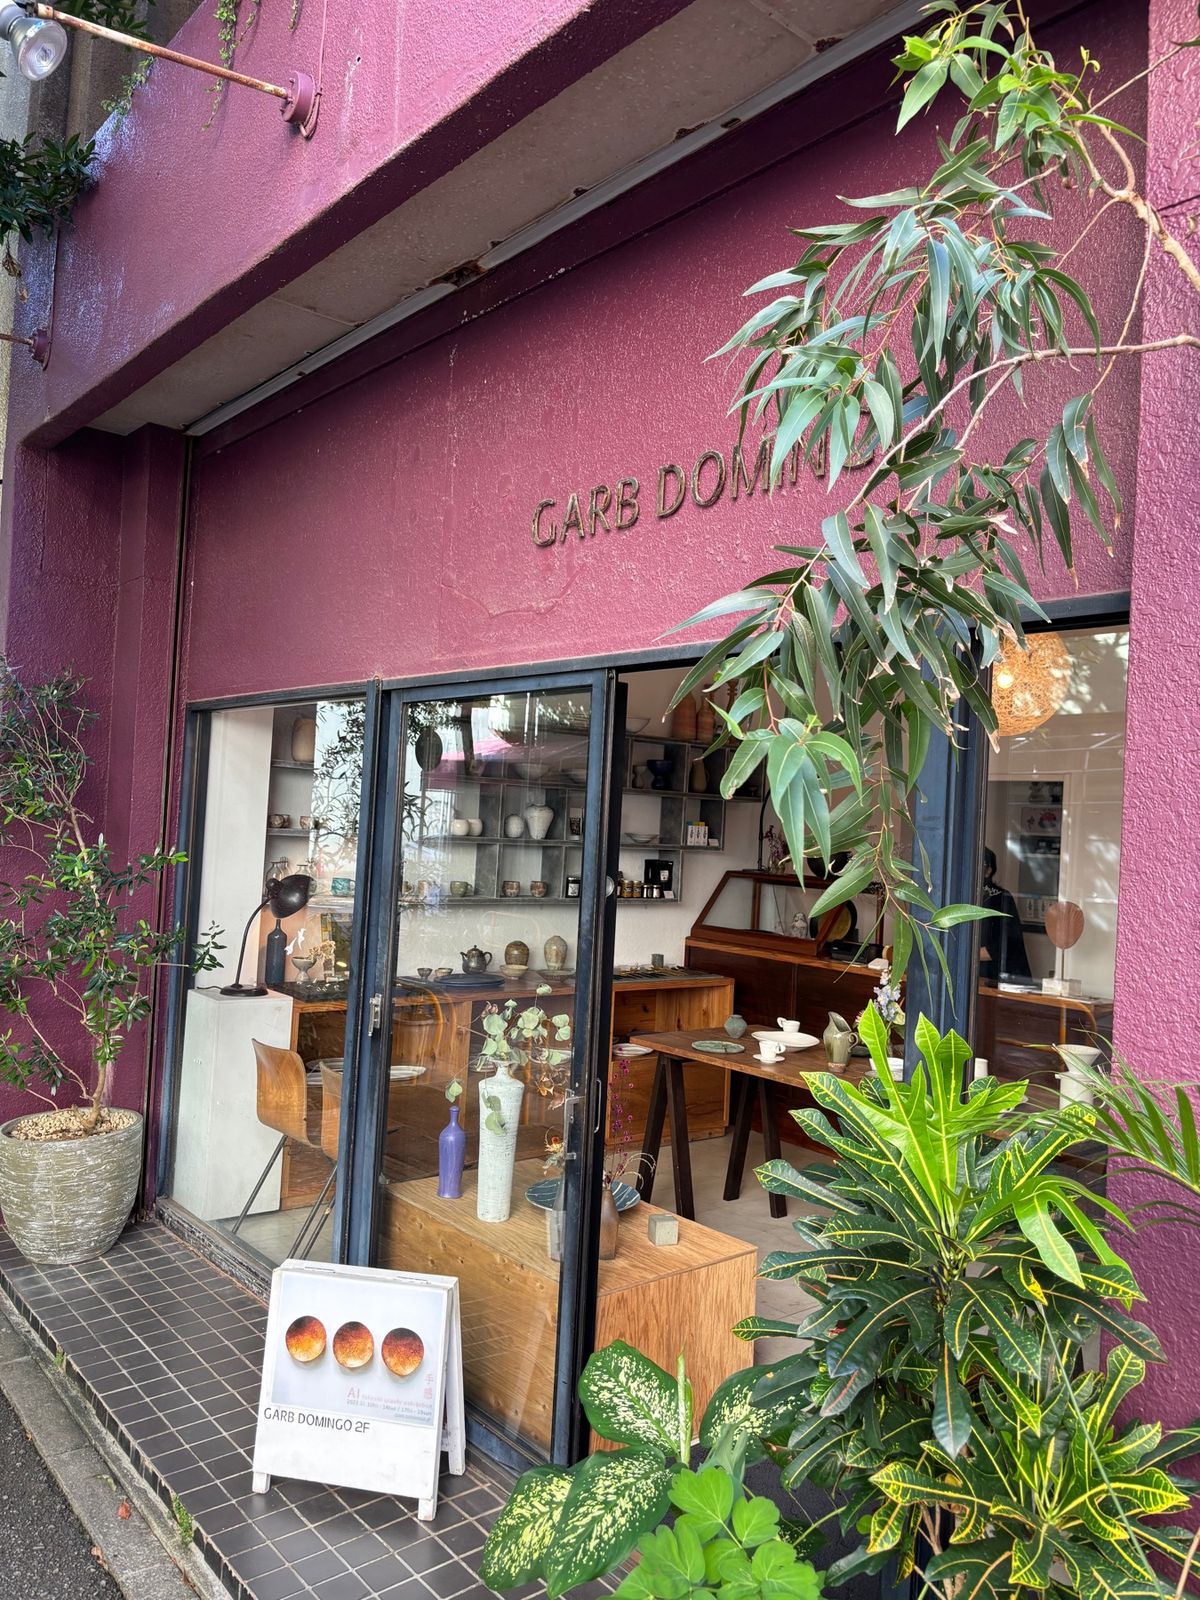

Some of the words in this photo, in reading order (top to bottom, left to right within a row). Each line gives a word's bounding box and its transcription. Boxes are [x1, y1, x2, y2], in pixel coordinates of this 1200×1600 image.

[531, 476, 640, 547] GARB
[264, 1407, 294, 1423] GARB
[298, 1412, 352, 1432] DOMINGO
[354, 1420, 370, 1433] 2F
